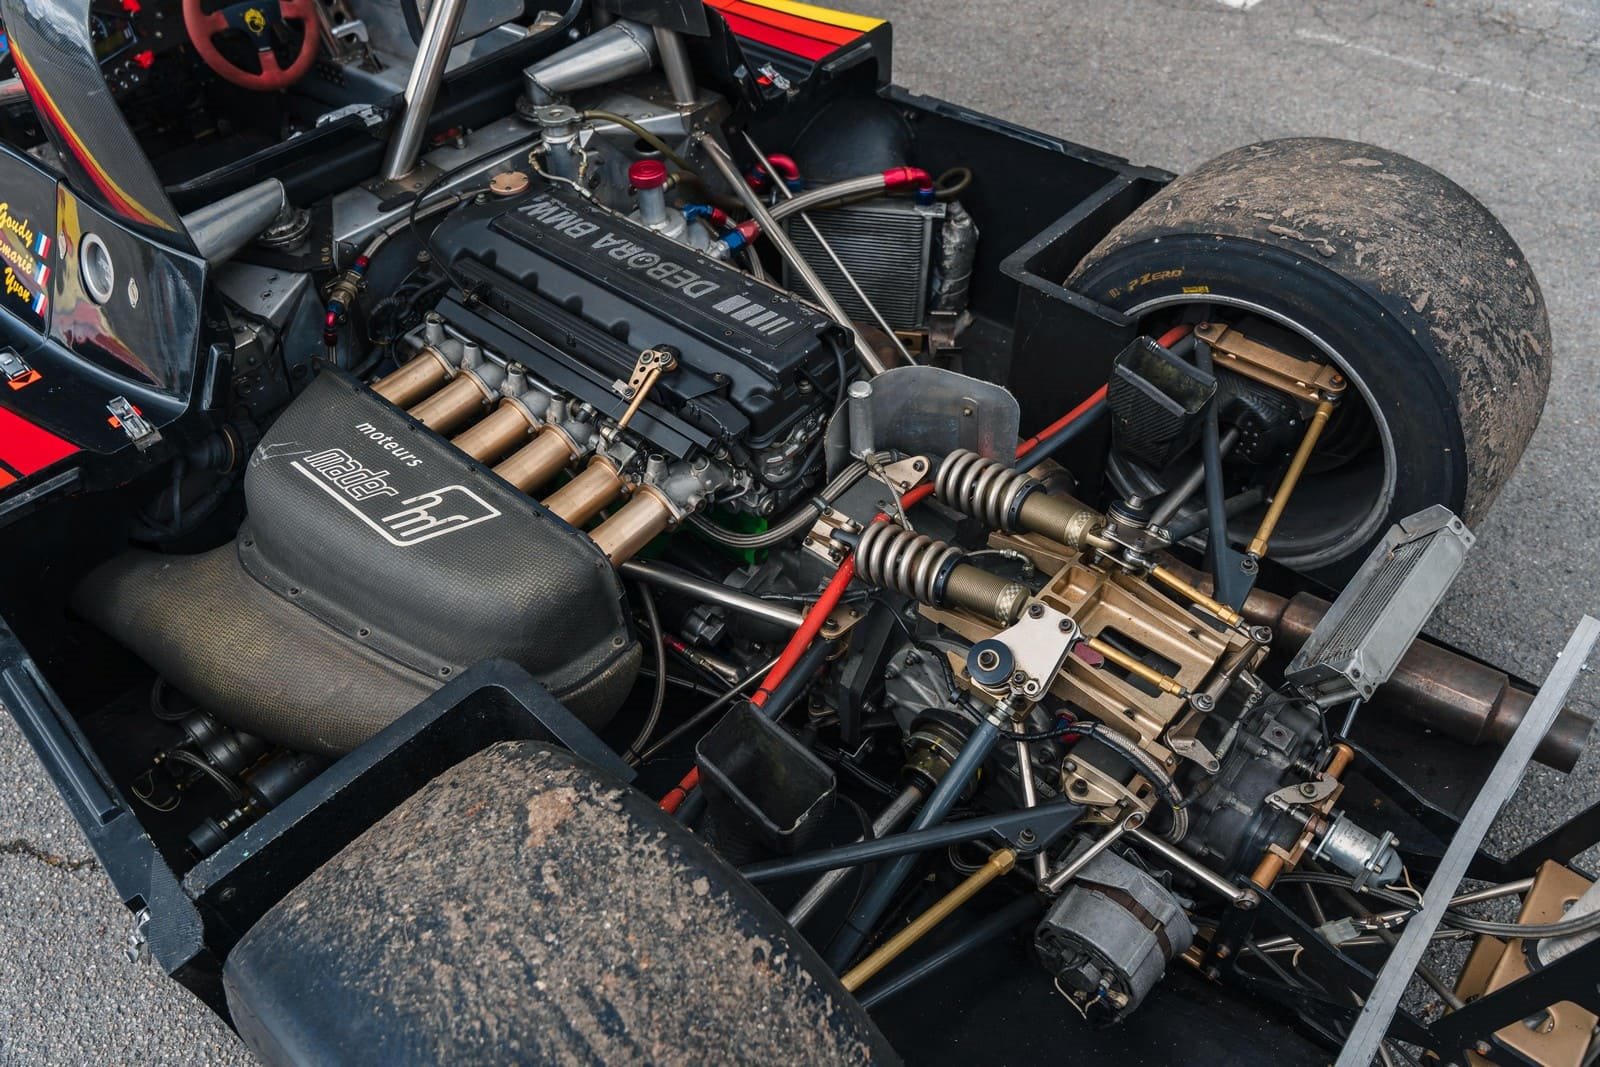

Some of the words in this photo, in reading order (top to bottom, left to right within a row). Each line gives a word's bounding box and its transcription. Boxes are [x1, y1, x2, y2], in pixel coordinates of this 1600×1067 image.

[517, 193, 601, 239] BMW
[4, 266, 31, 303] Yvon
[592, 232, 720, 298] DEBORA
[355, 422, 423, 468] moteurs
[303, 448, 399, 501] mader
